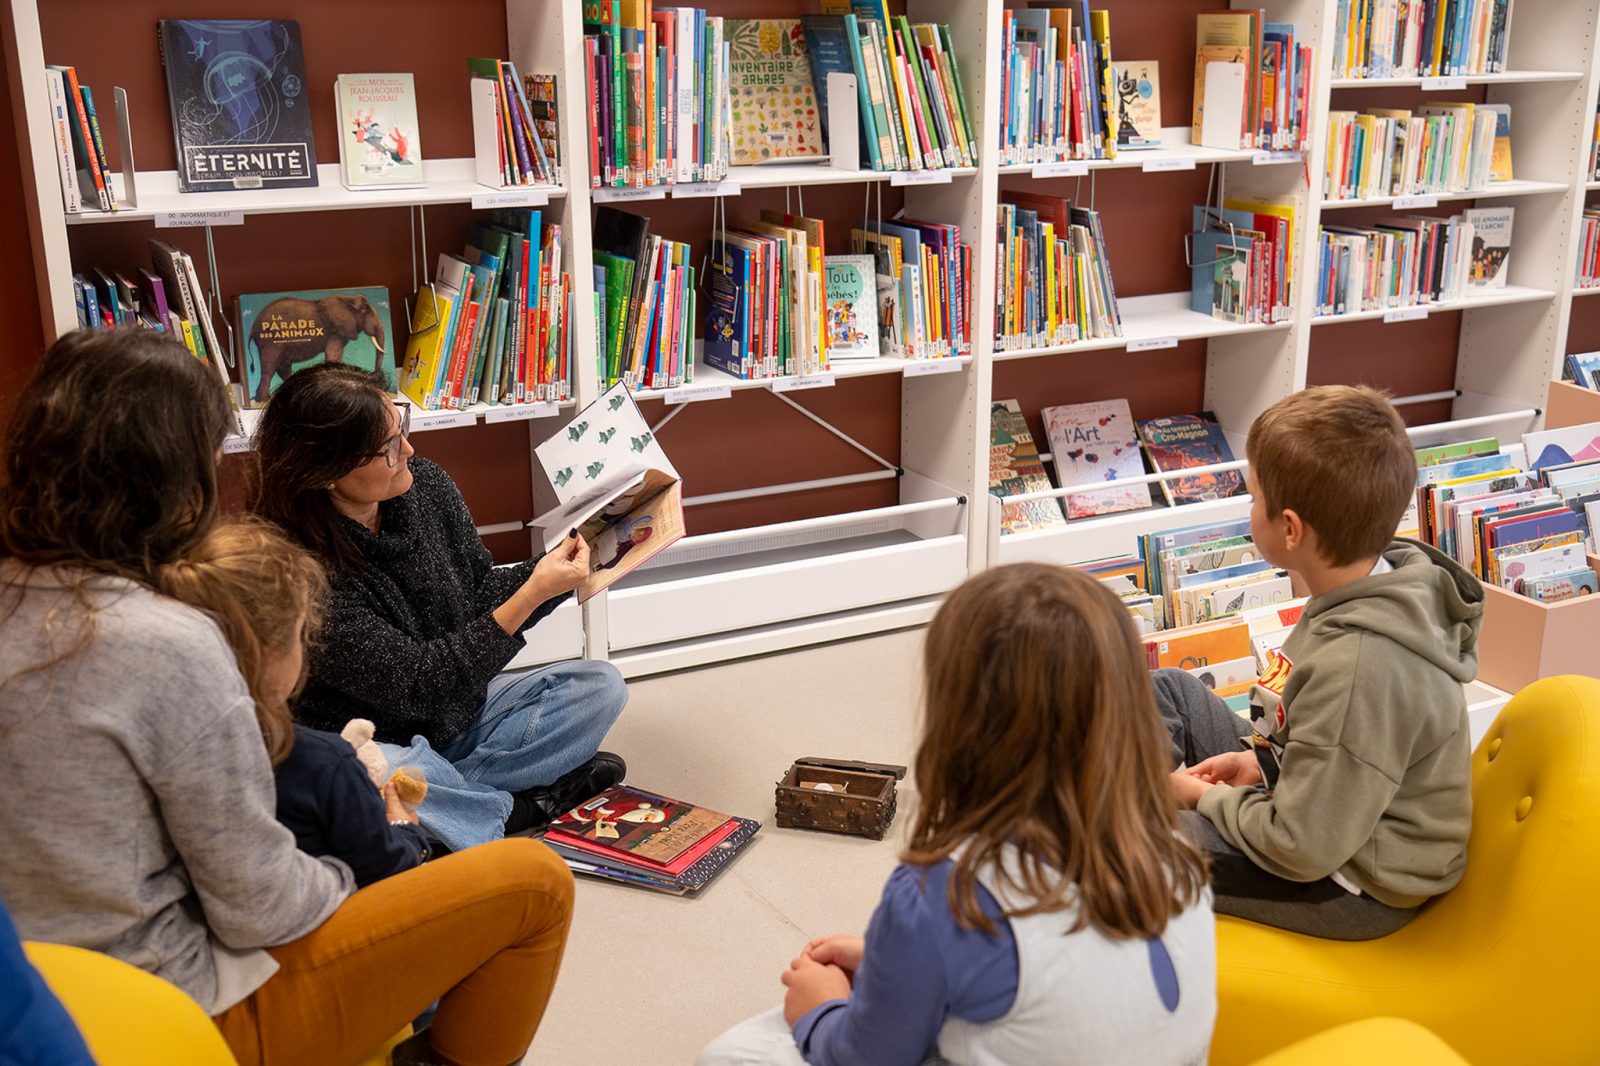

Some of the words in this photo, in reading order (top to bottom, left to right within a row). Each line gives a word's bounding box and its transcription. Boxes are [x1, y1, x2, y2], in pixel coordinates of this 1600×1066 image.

[731, 61, 793, 73] NVENTAIRE
[349, 87, 404, 96] JEAN-JACQUES
[194, 150, 301, 172] ÉTERNITÉ
[826, 267, 857, 284] Tout
[262, 319, 315, 331] PARADE
[273, 327, 324, 338] ANIMAUX
[1064, 426, 1101, 444] l'Art
[1161, 429, 1208, 442] Cro-Magnon
